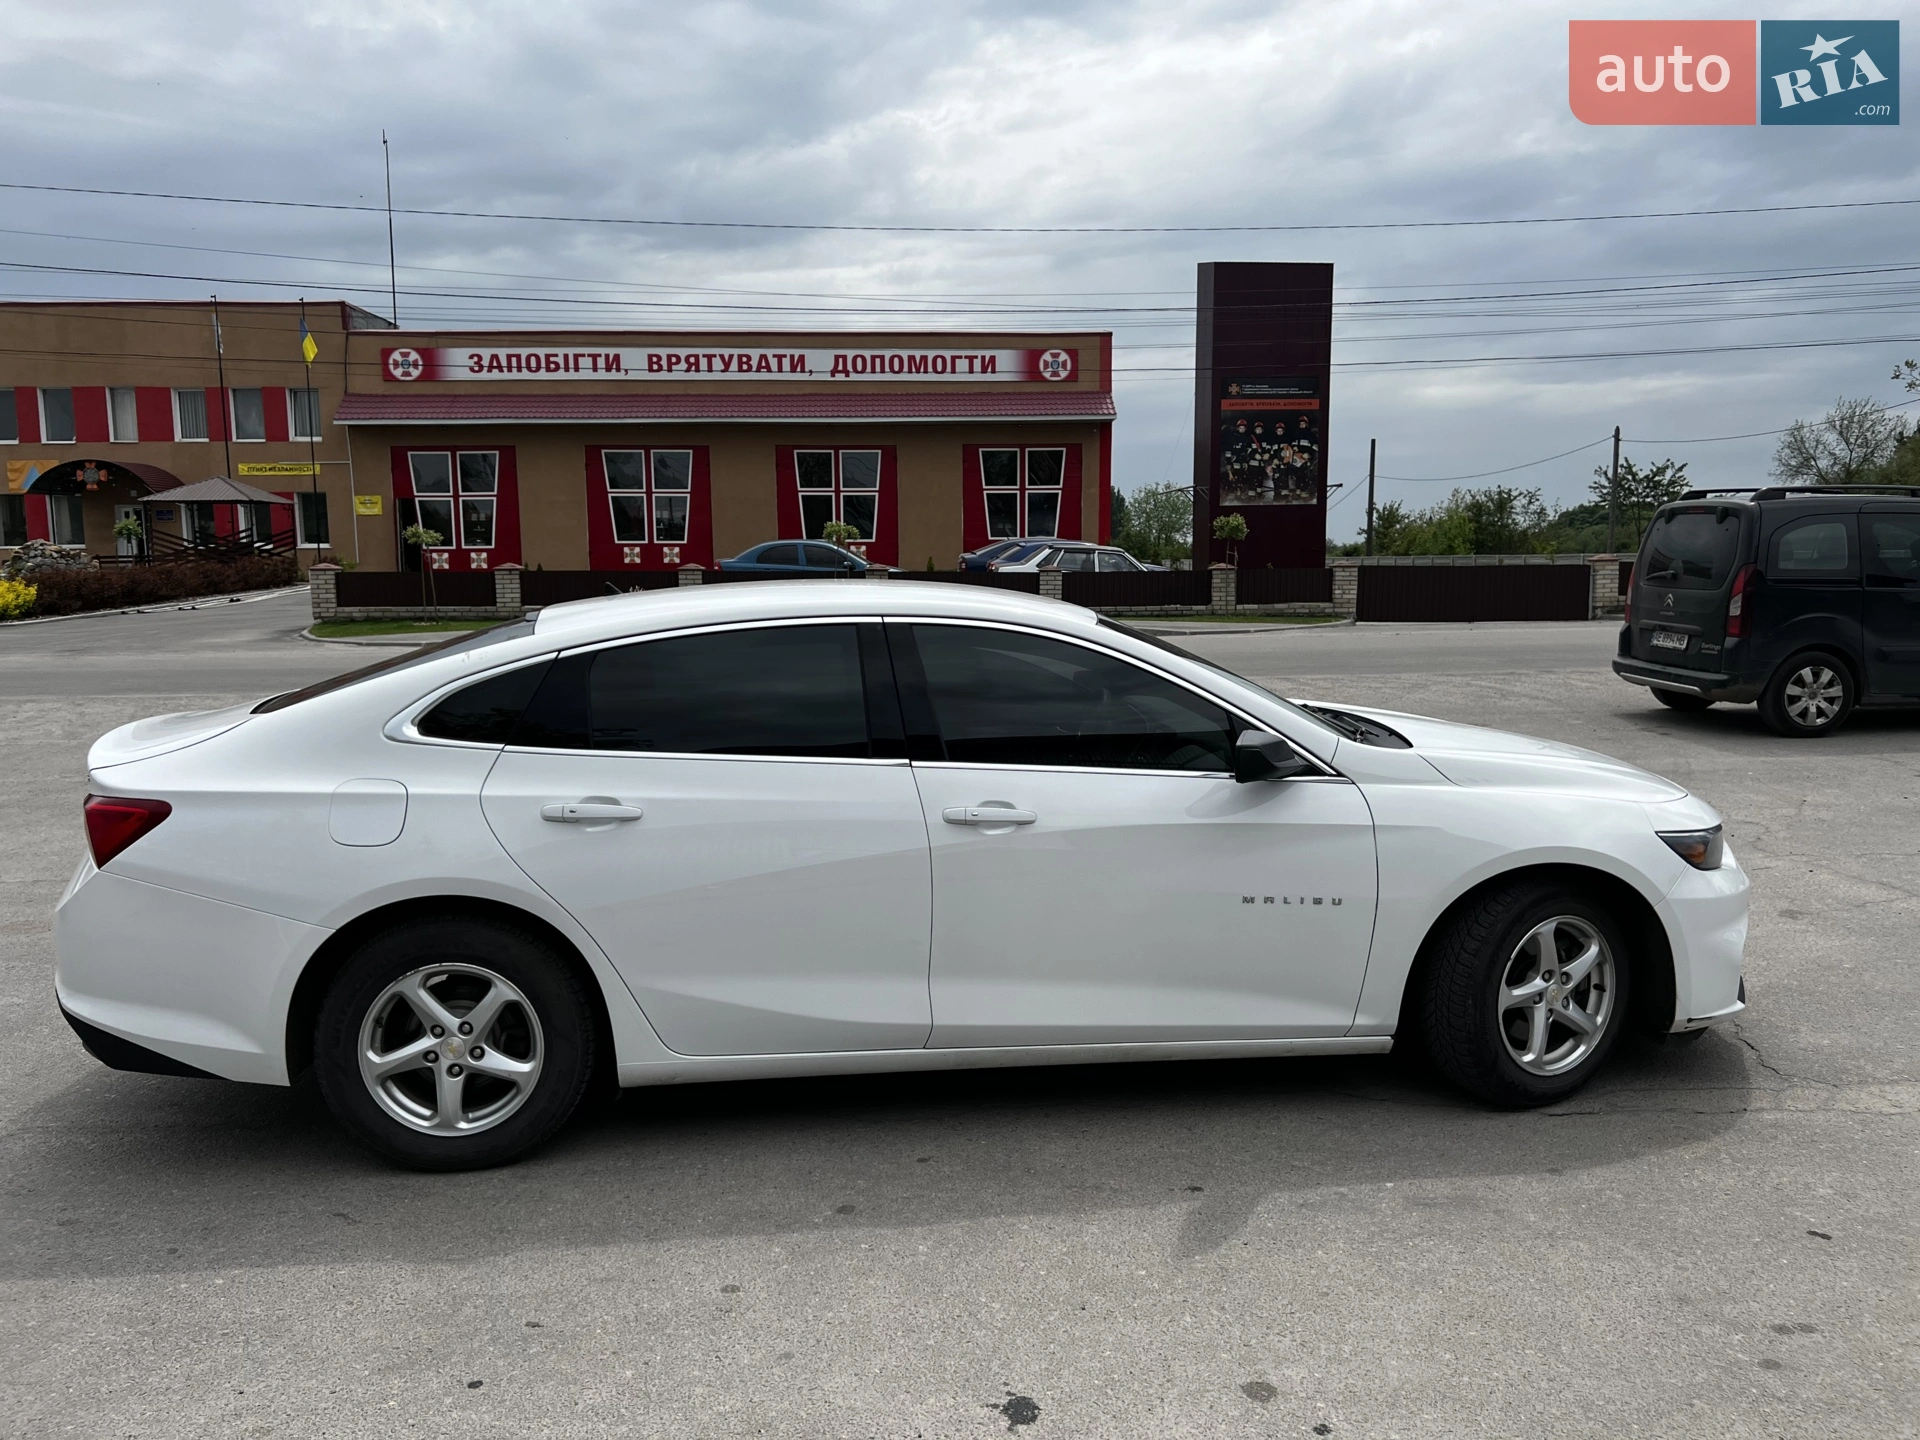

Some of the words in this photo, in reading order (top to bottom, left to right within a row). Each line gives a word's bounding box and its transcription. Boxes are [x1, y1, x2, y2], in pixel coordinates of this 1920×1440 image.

[468, 353, 629, 376] ЗАПОБІГТИ,
[647, 353, 813, 377] ВРЯТУВАТИ,
[830, 354, 997, 378] ДОПОМОГТИ
[1242, 896, 1342, 906] MALIBU
